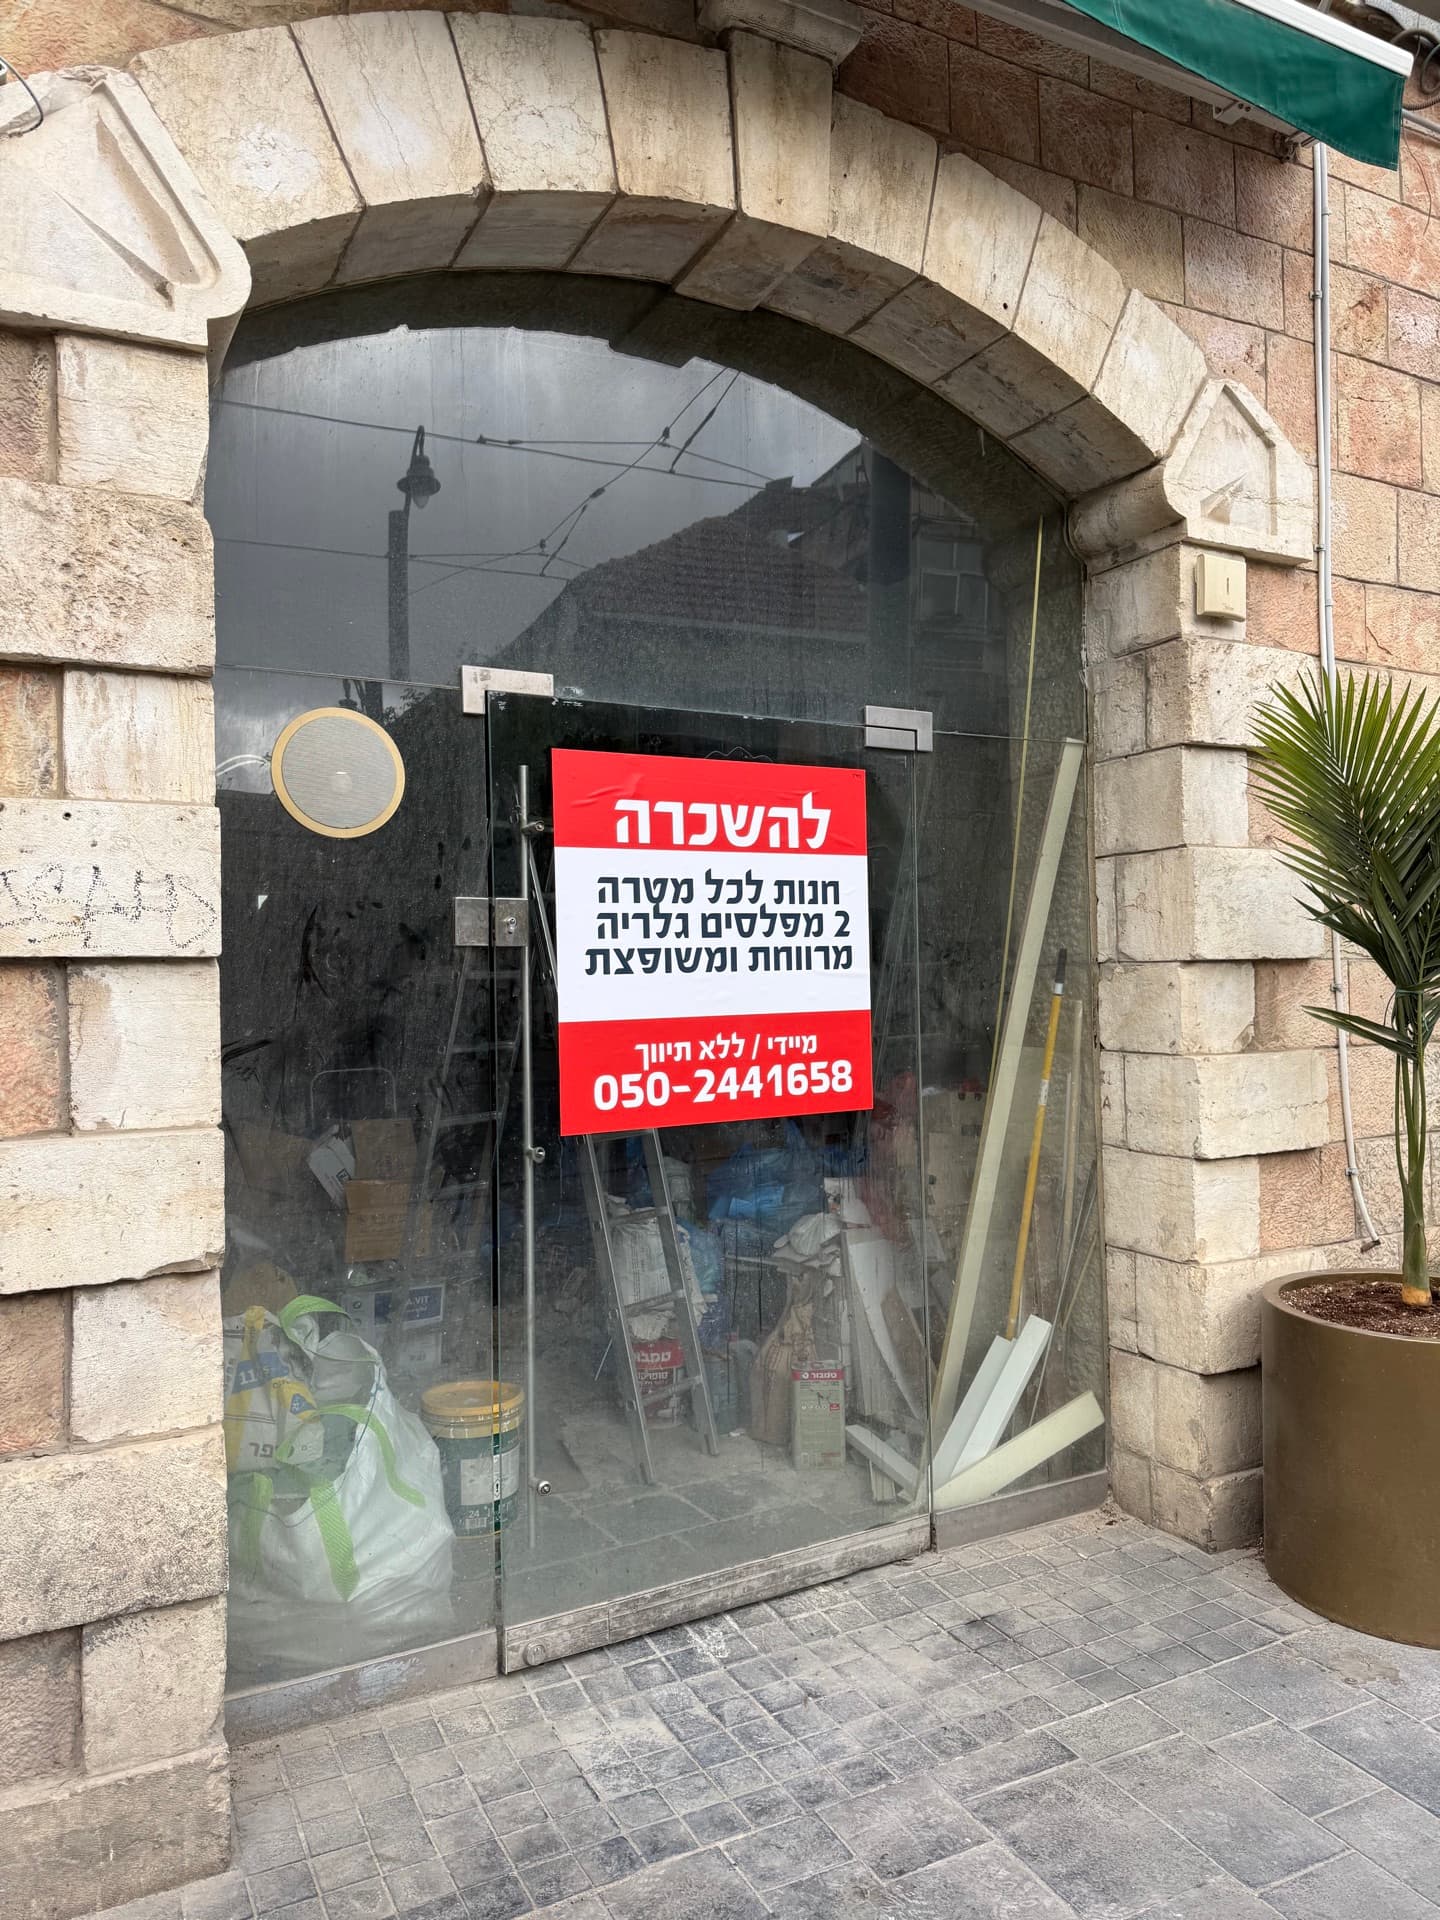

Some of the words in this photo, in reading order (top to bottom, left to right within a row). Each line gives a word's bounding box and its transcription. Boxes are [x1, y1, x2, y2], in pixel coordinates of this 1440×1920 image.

[614, 791, 832, 850] להשכרה
[597, 876, 694, 904] מטרה
[705, 868, 764, 904] לכל
[773, 879, 840, 905] חנות
[596, 902, 690, 939] גלריה
[701, 903, 824, 938] מפלסים
[834, 910, 850, 938] 2
[584, 946, 738, 976] ומשופצת
[748, 945, 853, 972] מרווחת
[634, 1041, 692, 1071] תיווך
[698, 1031, 745, 1060] ללא
[751, 1033, 761, 1060] /
[767, 1034, 818, 1056] מיידי
[593, 1059, 853, 1111] 050-2441658
[636, 1350, 672, 1364] טמבו
